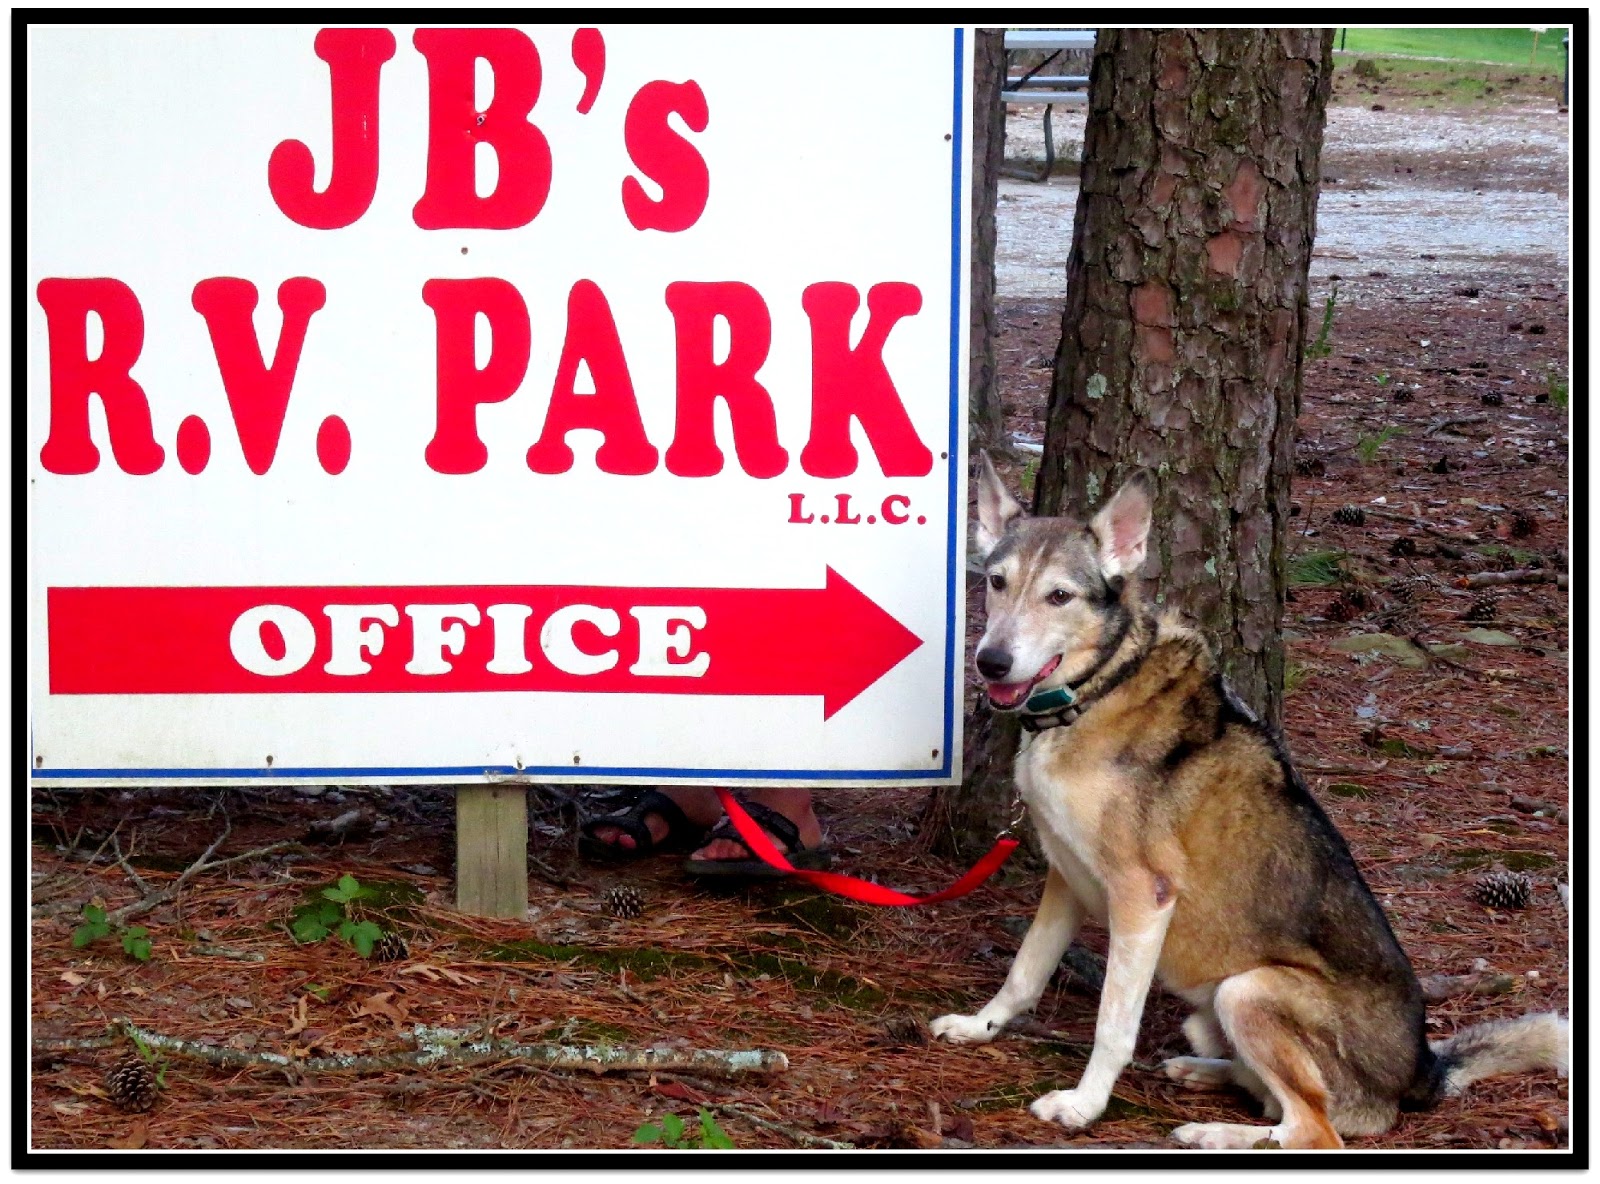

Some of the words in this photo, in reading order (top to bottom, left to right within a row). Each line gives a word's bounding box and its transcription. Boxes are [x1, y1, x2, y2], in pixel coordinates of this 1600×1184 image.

[268, 28, 709, 231] JB's
[37, 277, 351, 475] R.V.
[421, 278, 933, 478] PARK
[787, 493, 928, 525] L.L.C.
[229, 603, 710, 677] OFFICE
